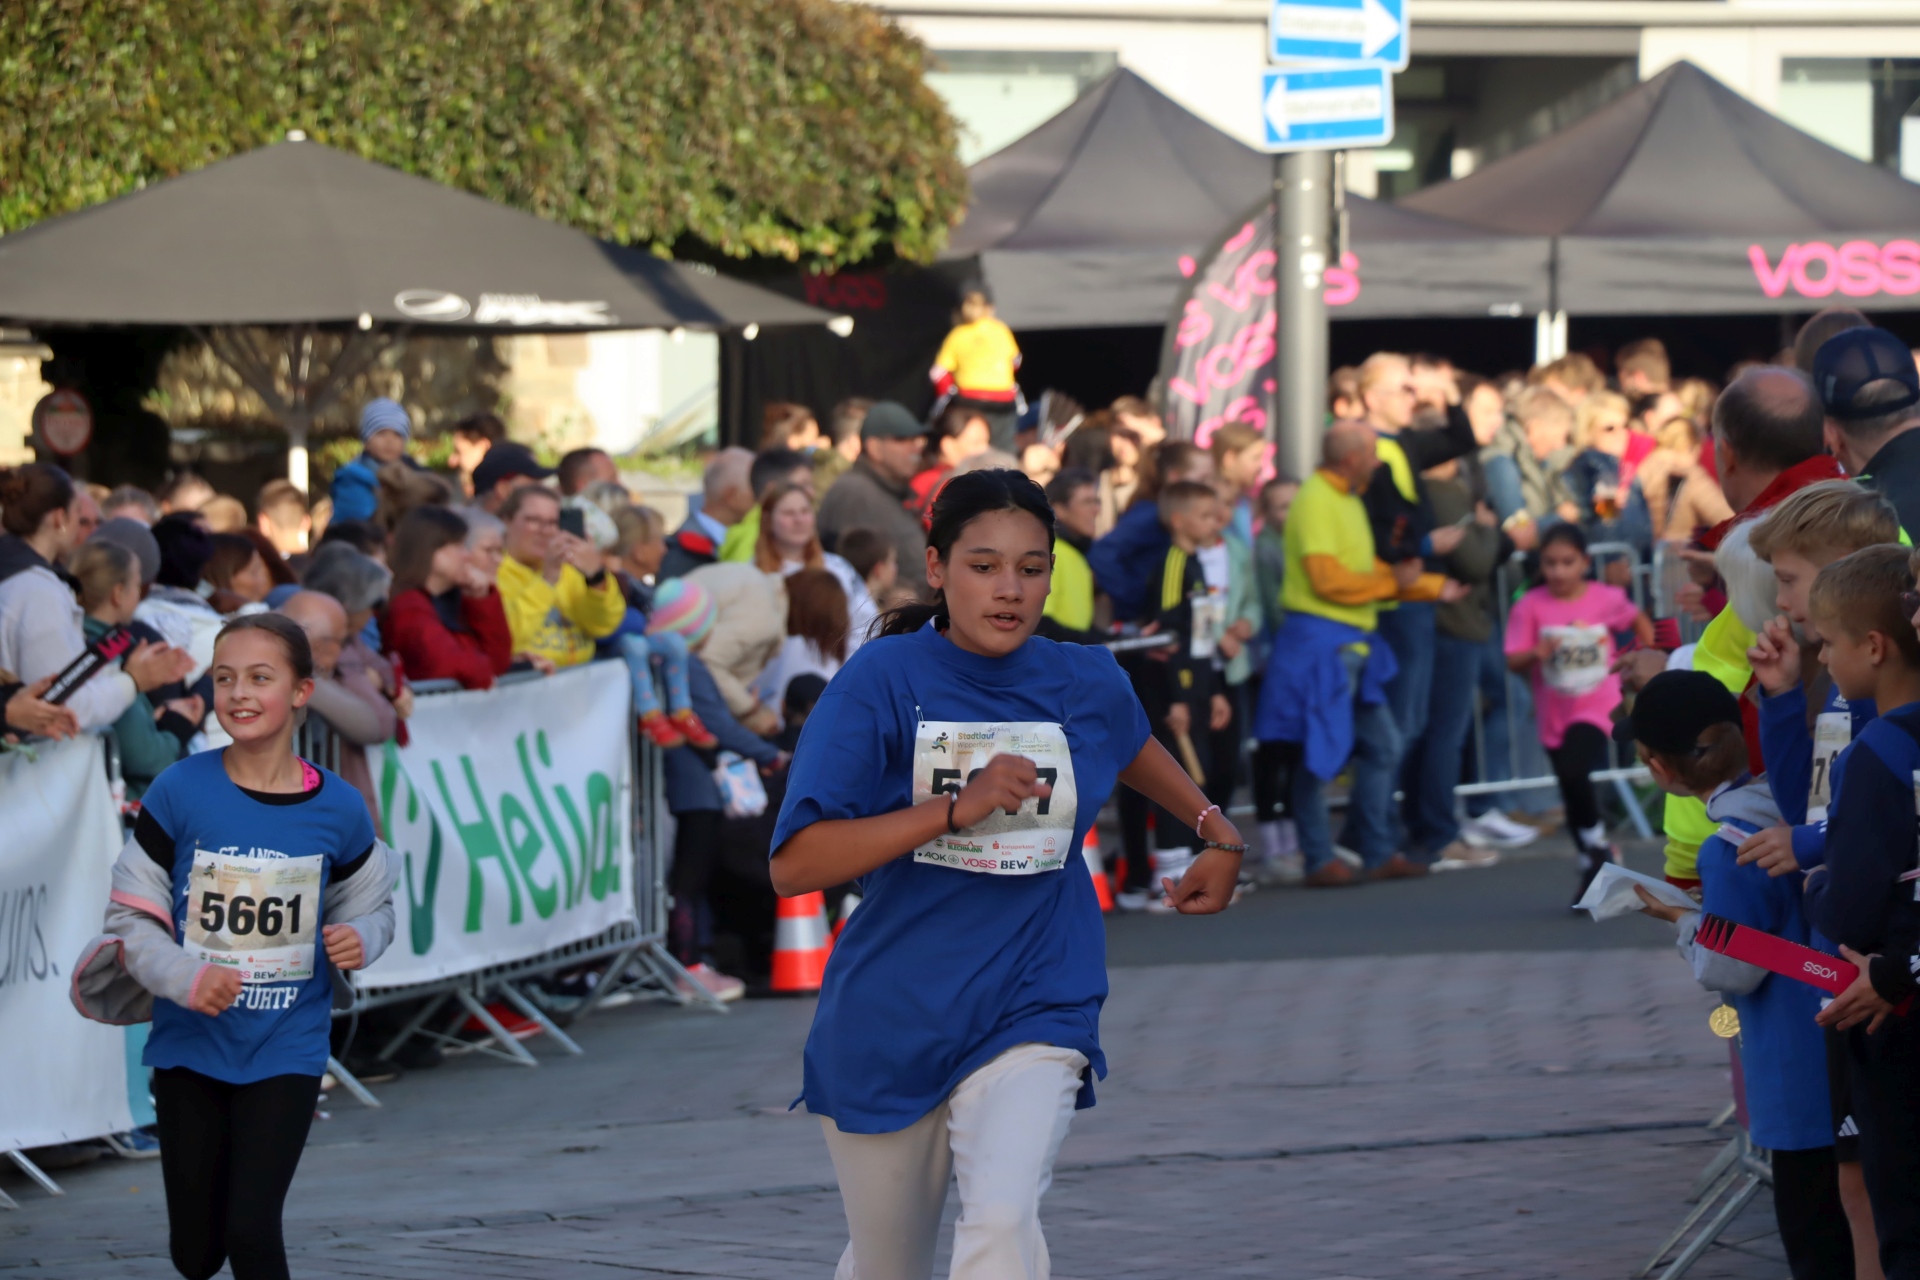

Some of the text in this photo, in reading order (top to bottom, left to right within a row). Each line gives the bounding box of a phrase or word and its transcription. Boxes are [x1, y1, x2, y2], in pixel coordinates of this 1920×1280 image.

[1747, 239, 1920, 298] VOSS
[957, 732, 995, 740] Stadtlauf
[931, 767, 1057, 815] 57
[430, 729, 622, 934] Helio
[924, 851, 947, 863] AOK
[961, 857, 997, 869] VOSS
[1000, 860, 1028, 869] BEW
[223, 863, 261, 874] Stadtlauf
[200, 890, 302, 936] 5661
[254, 971, 277, 979] BEW
[1802, 961, 1837, 981] VOSS
[229, 984, 299, 1010] FÜRTH
